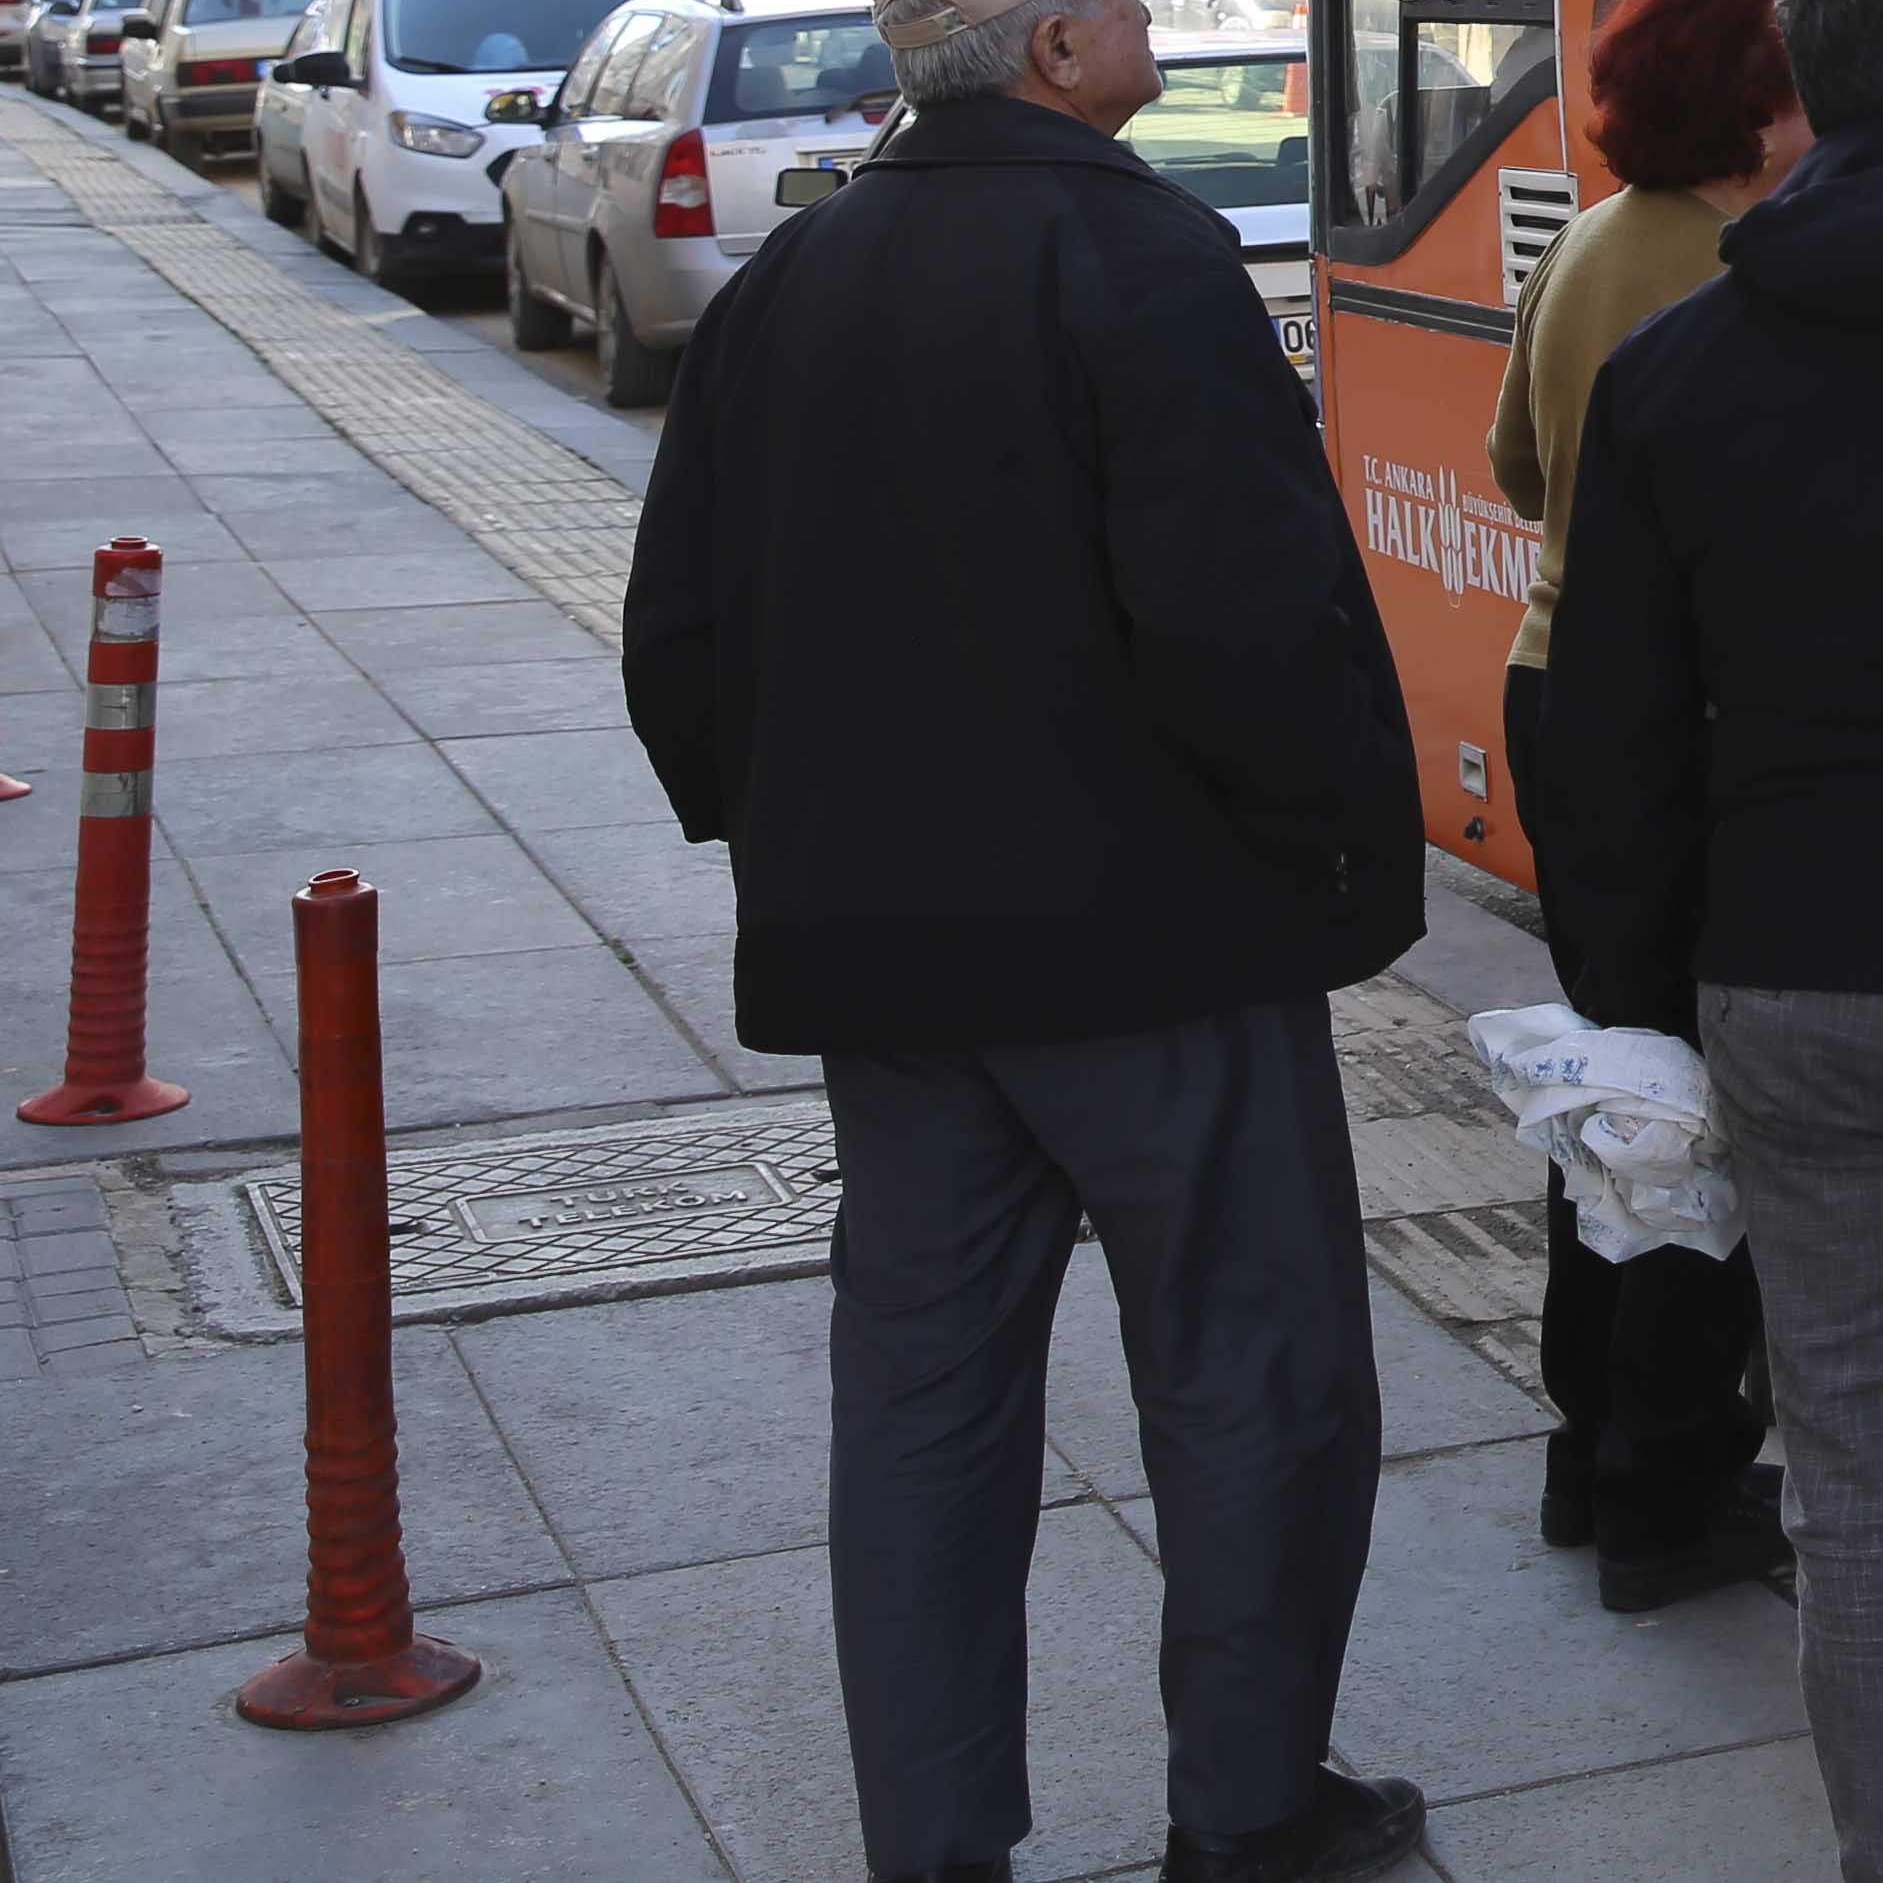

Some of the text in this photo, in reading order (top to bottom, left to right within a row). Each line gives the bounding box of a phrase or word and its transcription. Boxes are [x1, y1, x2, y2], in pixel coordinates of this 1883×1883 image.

[1363, 454, 1435, 502] T.C. ANKARA
[1365, 488, 1543, 605] HALK EKME
[517, 1189, 749, 1229] TELEKOM
